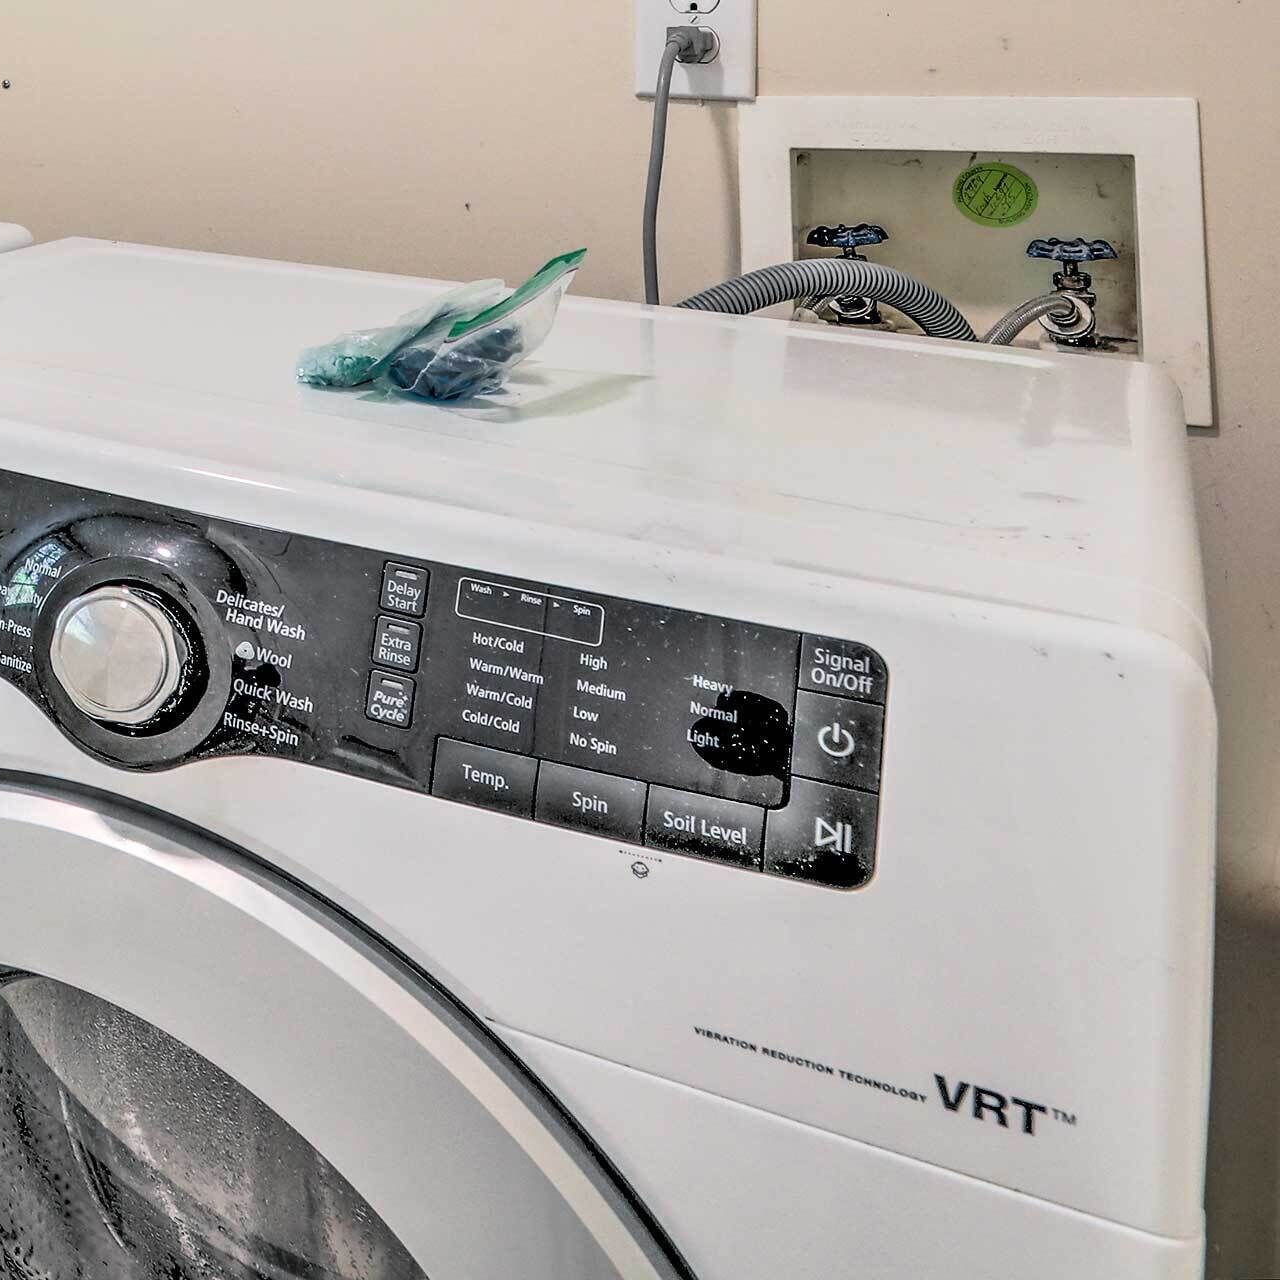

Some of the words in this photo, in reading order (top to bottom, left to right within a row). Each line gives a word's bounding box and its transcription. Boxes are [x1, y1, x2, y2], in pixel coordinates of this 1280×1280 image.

[24, 558, 63, 579] Normal
[387, 580, 422, 600] Delay
[470, 583, 493, 595] Wash
[520, 593, 543, 606] Rinse
[216, 589, 286, 618] Delicates/
[388, 595, 418, 613] Start
[573, 604, 591, 616] Spin
[7, 618, 32, 638] Press
[225, 608, 264, 630] Hand
[266, 619, 306, 641] Wash
[381, 633, 412, 652] Extra
[472, 631, 525, 654] Hot/Cold
[255, 646, 293, 669] Wool
[378, 648, 411, 666] Rinse
[579, 653, 608, 671] High
[814, 647, 871, 674] Signal
[469, 656, 544, 685] Warm/Warm
[811, 667, 874, 695] On/Off
[232, 678, 273, 702] Quick
[275, 689, 314, 713] Wash
[466, 683, 533, 710] Warm/Cold
[576, 679, 627, 702] Medium
[692, 674, 733, 697] Heavy
[372, 690, 405, 708] Pure
[370, 704, 406, 723] Cycle
[462, 709, 521, 734] Cold/Cold
[573, 706, 599, 723] Low
[690, 700, 738, 724] Normal
[223, 711, 300, 747] Rinse+Spin
[686, 727, 720, 749] Light
[569, 732, 588, 748] No
[589, 737, 617, 756] Spin
[462, 763, 510, 792] Temp.
[572, 791, 608, 814] Spin
[663, 810, 696, 834] Soil
[701, 819, 747, 846] Level
[693, 1025, 758, 1054] VIBRATION
[761, 1046, 835, 1077] REDUCTION
[838, 1069, 928, 1104] TECHNOLOGY
[933, 1072, 1048, 1138] VRT
